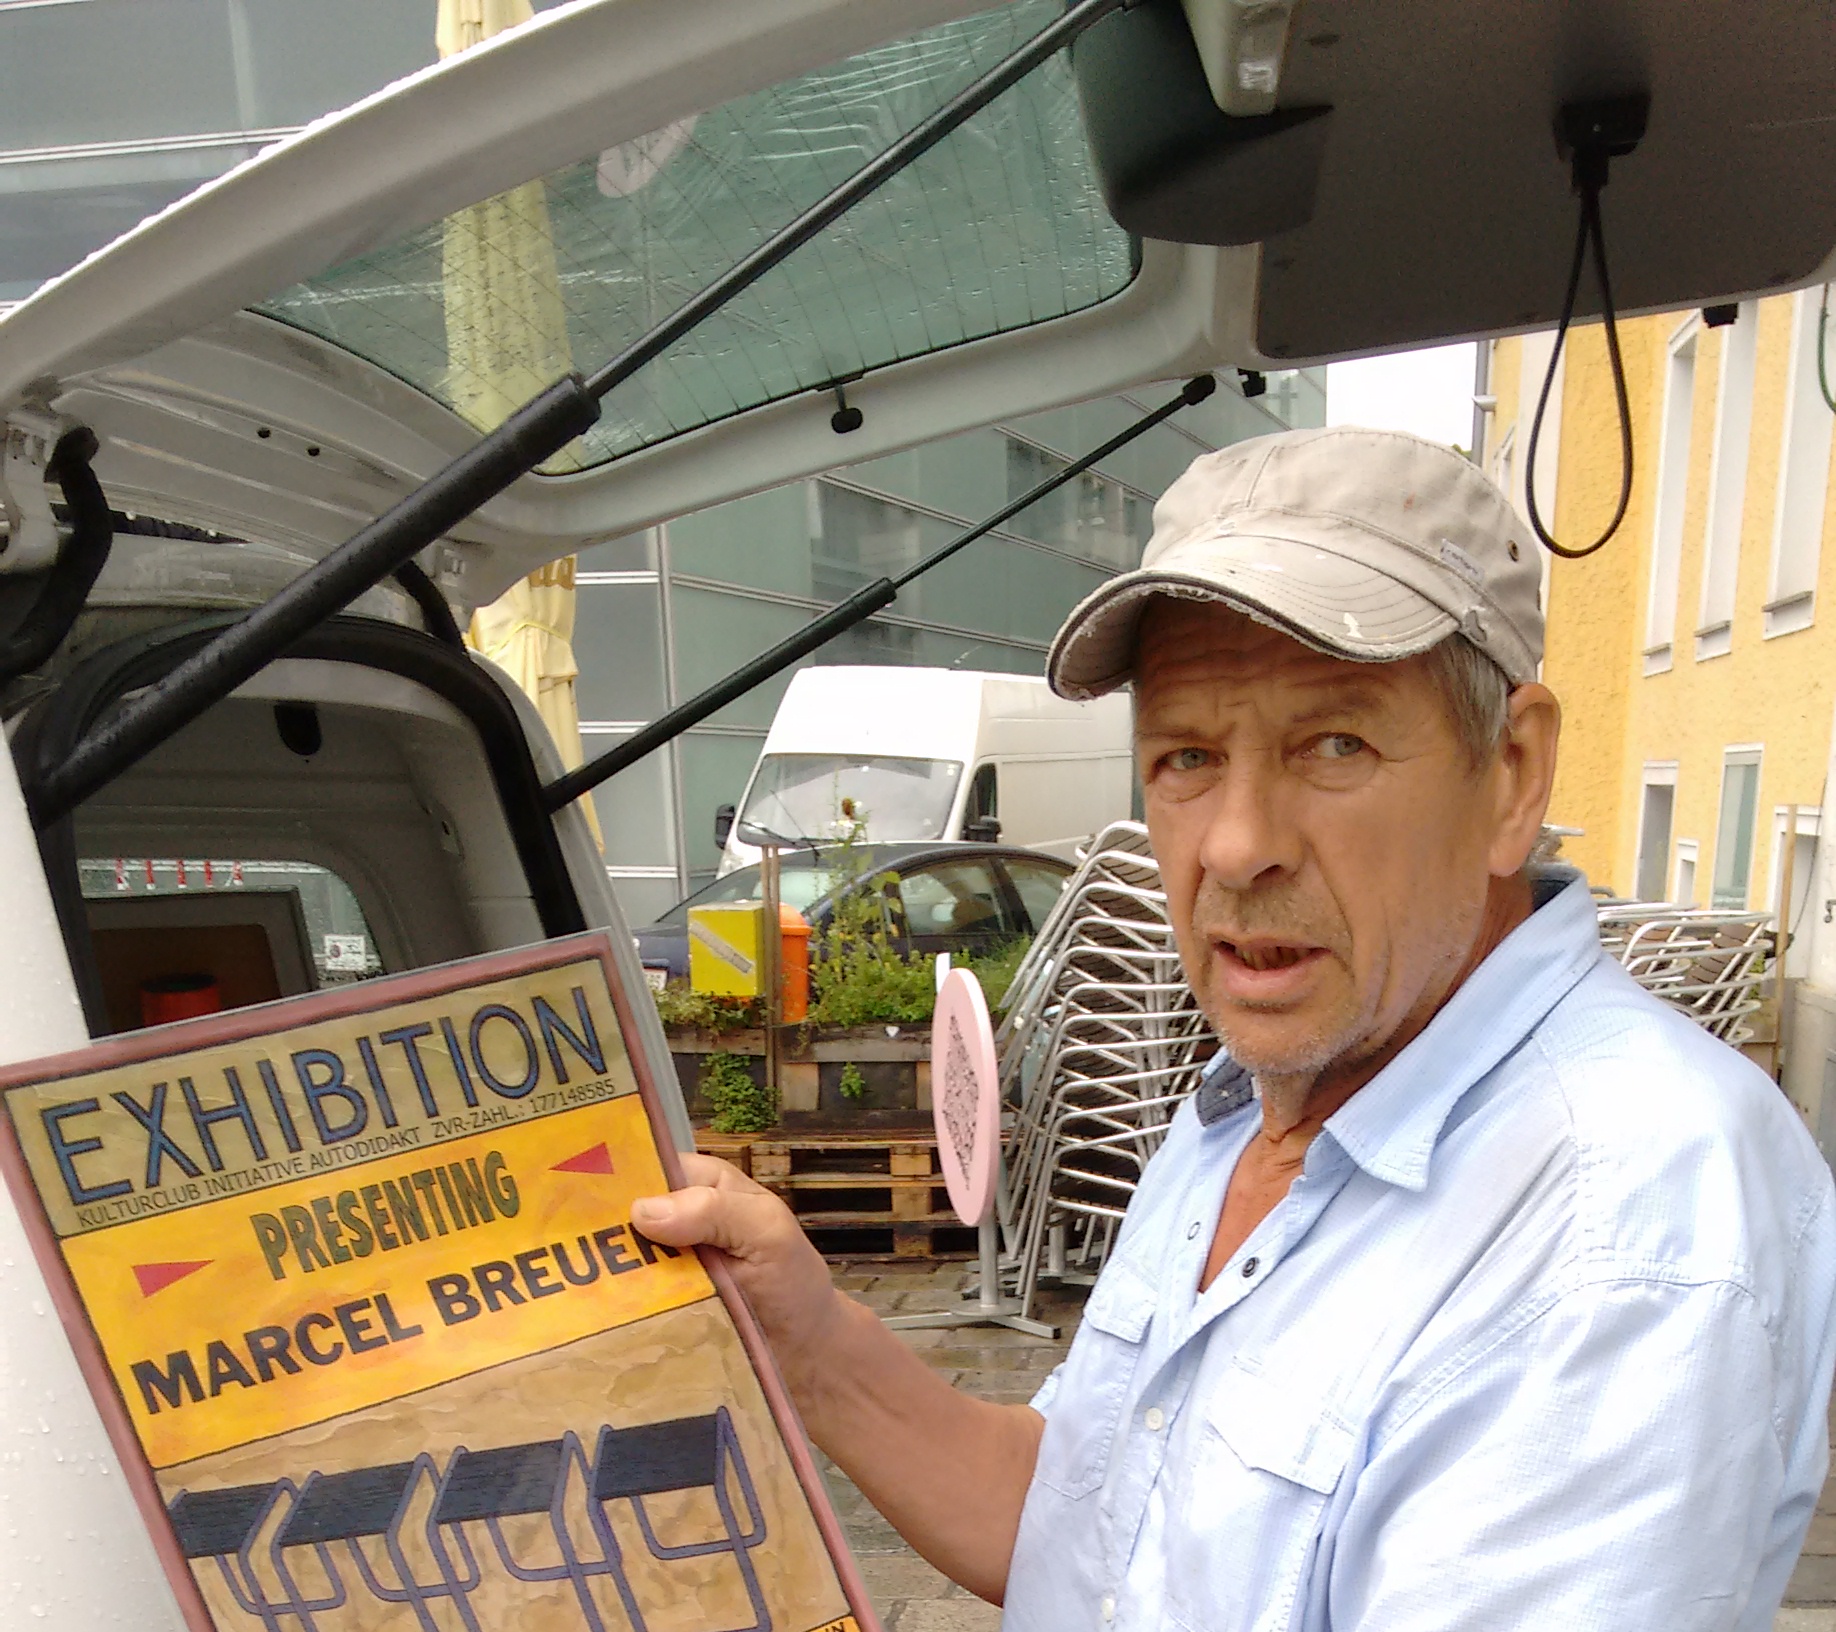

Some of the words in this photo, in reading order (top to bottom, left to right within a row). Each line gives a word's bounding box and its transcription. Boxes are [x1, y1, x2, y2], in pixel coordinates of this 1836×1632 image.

[41, 986, 608, 1206] EXHIBITION
[76, 1183, 201, 1227] KULTURCLUB
[208, 1156, 303, 1196] INITIATIVE
[311, 1127, 421, 1170] AUTODIDAKT
[431, 1104, 525, 1139] ZVR-ZAHL.:
[530, 1079, 616, 1114] 177148585
[250, 1150, 521, 1280] PRESENTING
[130, 1292, 423, 1415] MARCEL
